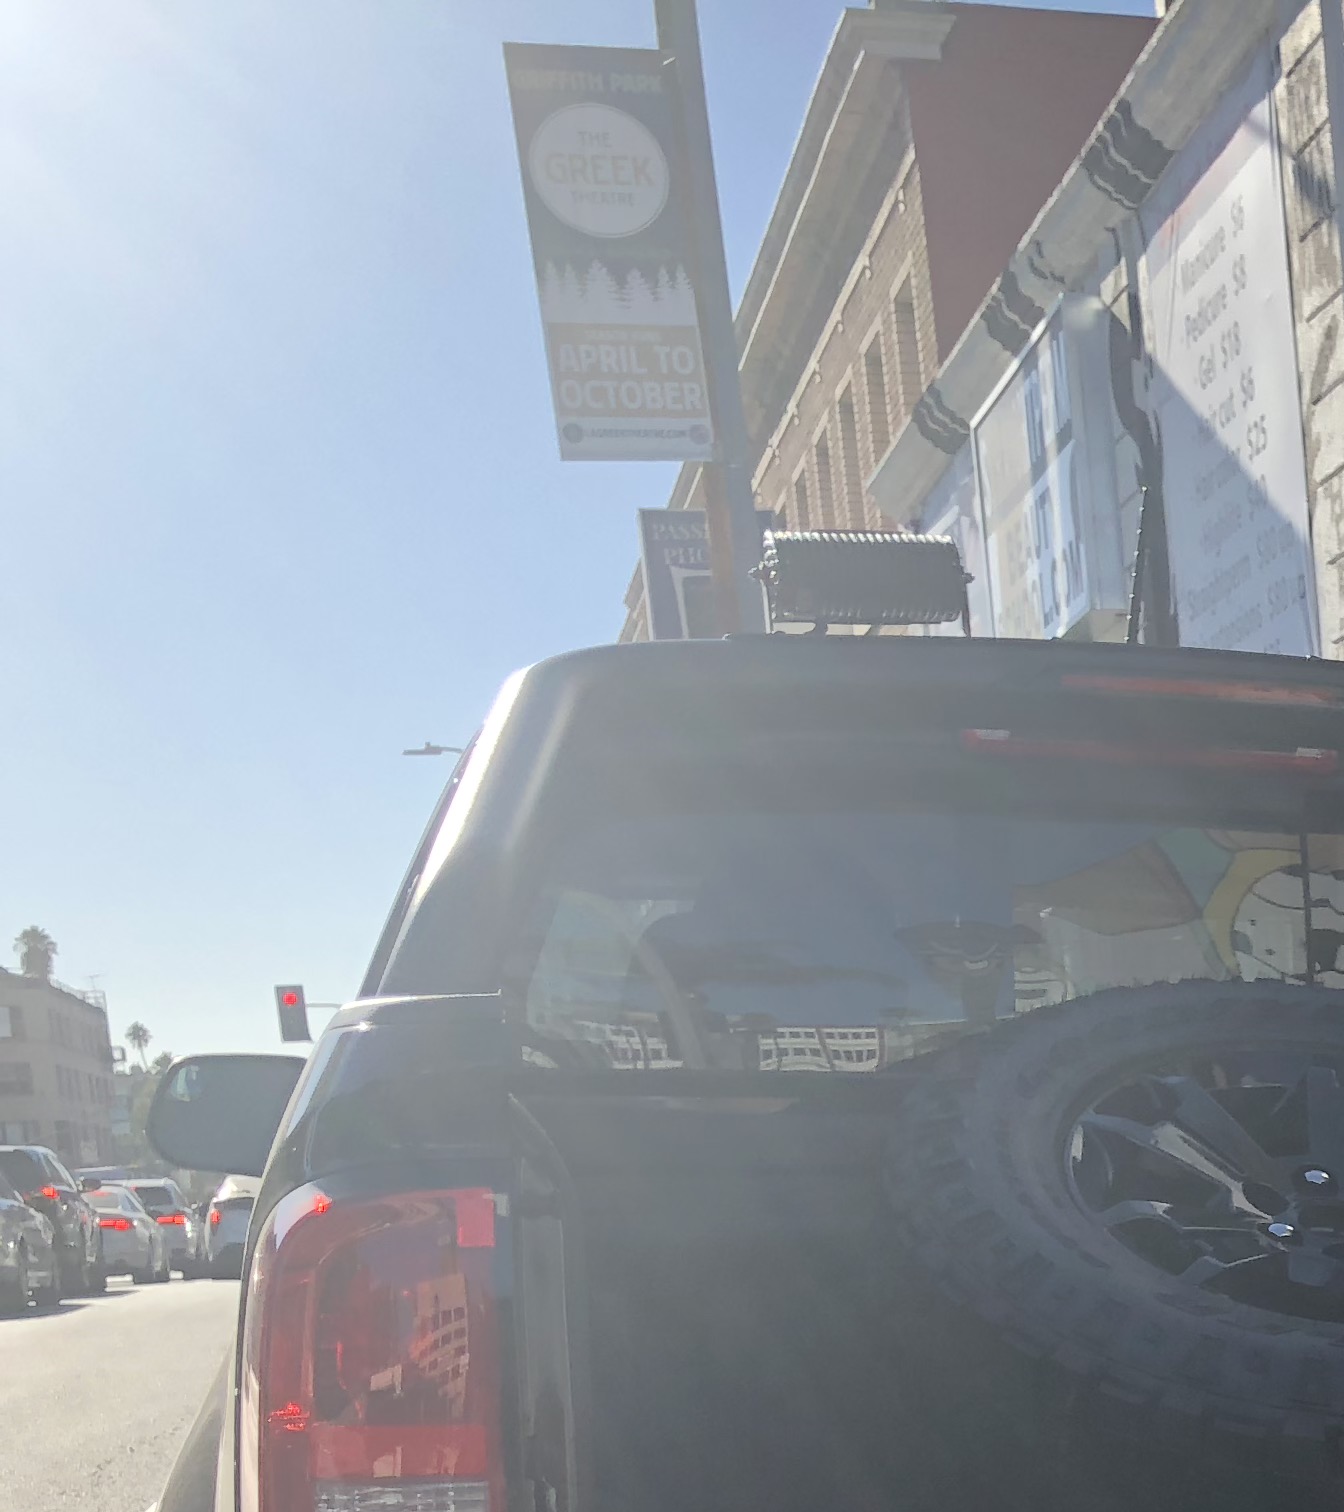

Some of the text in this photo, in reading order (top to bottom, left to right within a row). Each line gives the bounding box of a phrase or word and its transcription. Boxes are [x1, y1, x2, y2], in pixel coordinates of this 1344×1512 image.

[609, 72, 662, 94] PARK
[577, 130, 613, 148] THE
[545, 152, 657, 187] GREEK
[558, 343, 696, 375] APRIL TO
[1199, 343, 1217, 391] Gel
[559, 379, 703, 410] OCTOBER
[1246, 413, 1268, 462] $25
